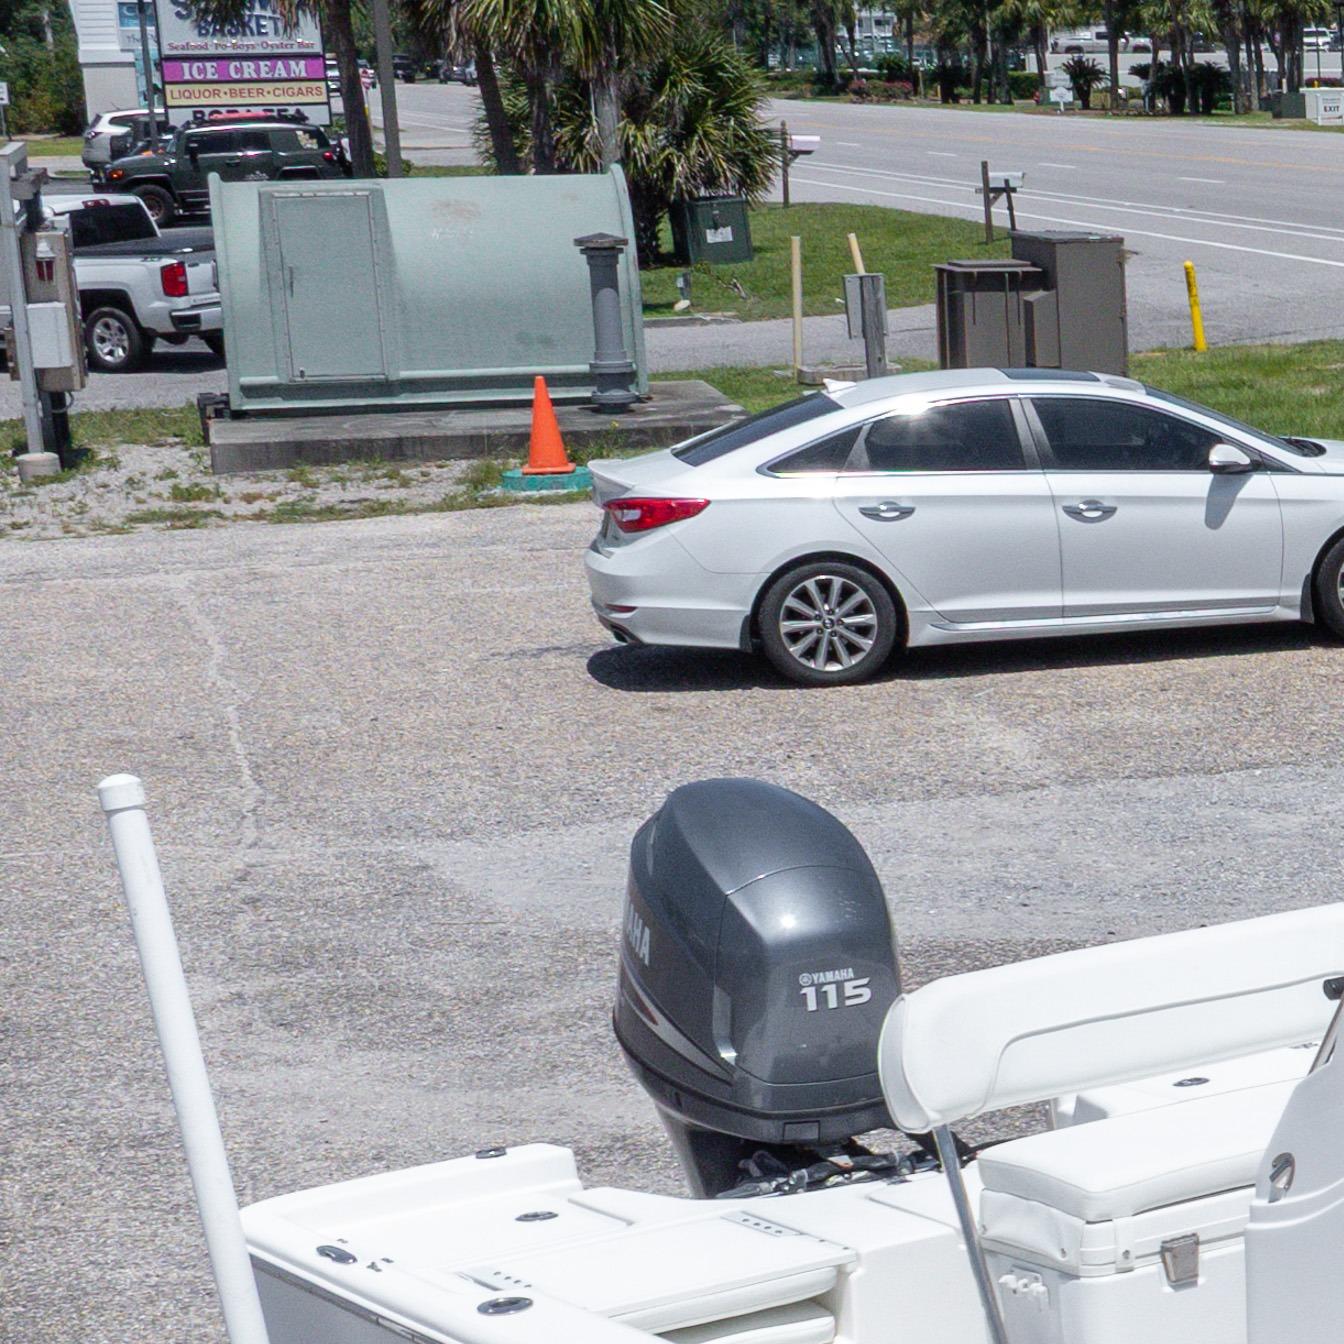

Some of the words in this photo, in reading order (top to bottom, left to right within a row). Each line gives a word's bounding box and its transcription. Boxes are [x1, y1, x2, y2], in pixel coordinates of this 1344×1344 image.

[168, 41, 208, 50] Seafood
[215, 41, 255, 51] Po-Boys
[261, 40, 294, 50] Oyster
[298, 40, 315, 48] Bar
[182, 62, 218, 80] ICE
[229, 60, 308, 79] CREAM
[170, 88, 221, 100] LIQUOR
[229, 87, 265, 98] BEER
[272, 86, 323, 97] CIGARS
[812, 967, 855, 985] YAMAHA
[800, 976, 872, 1013] 115
